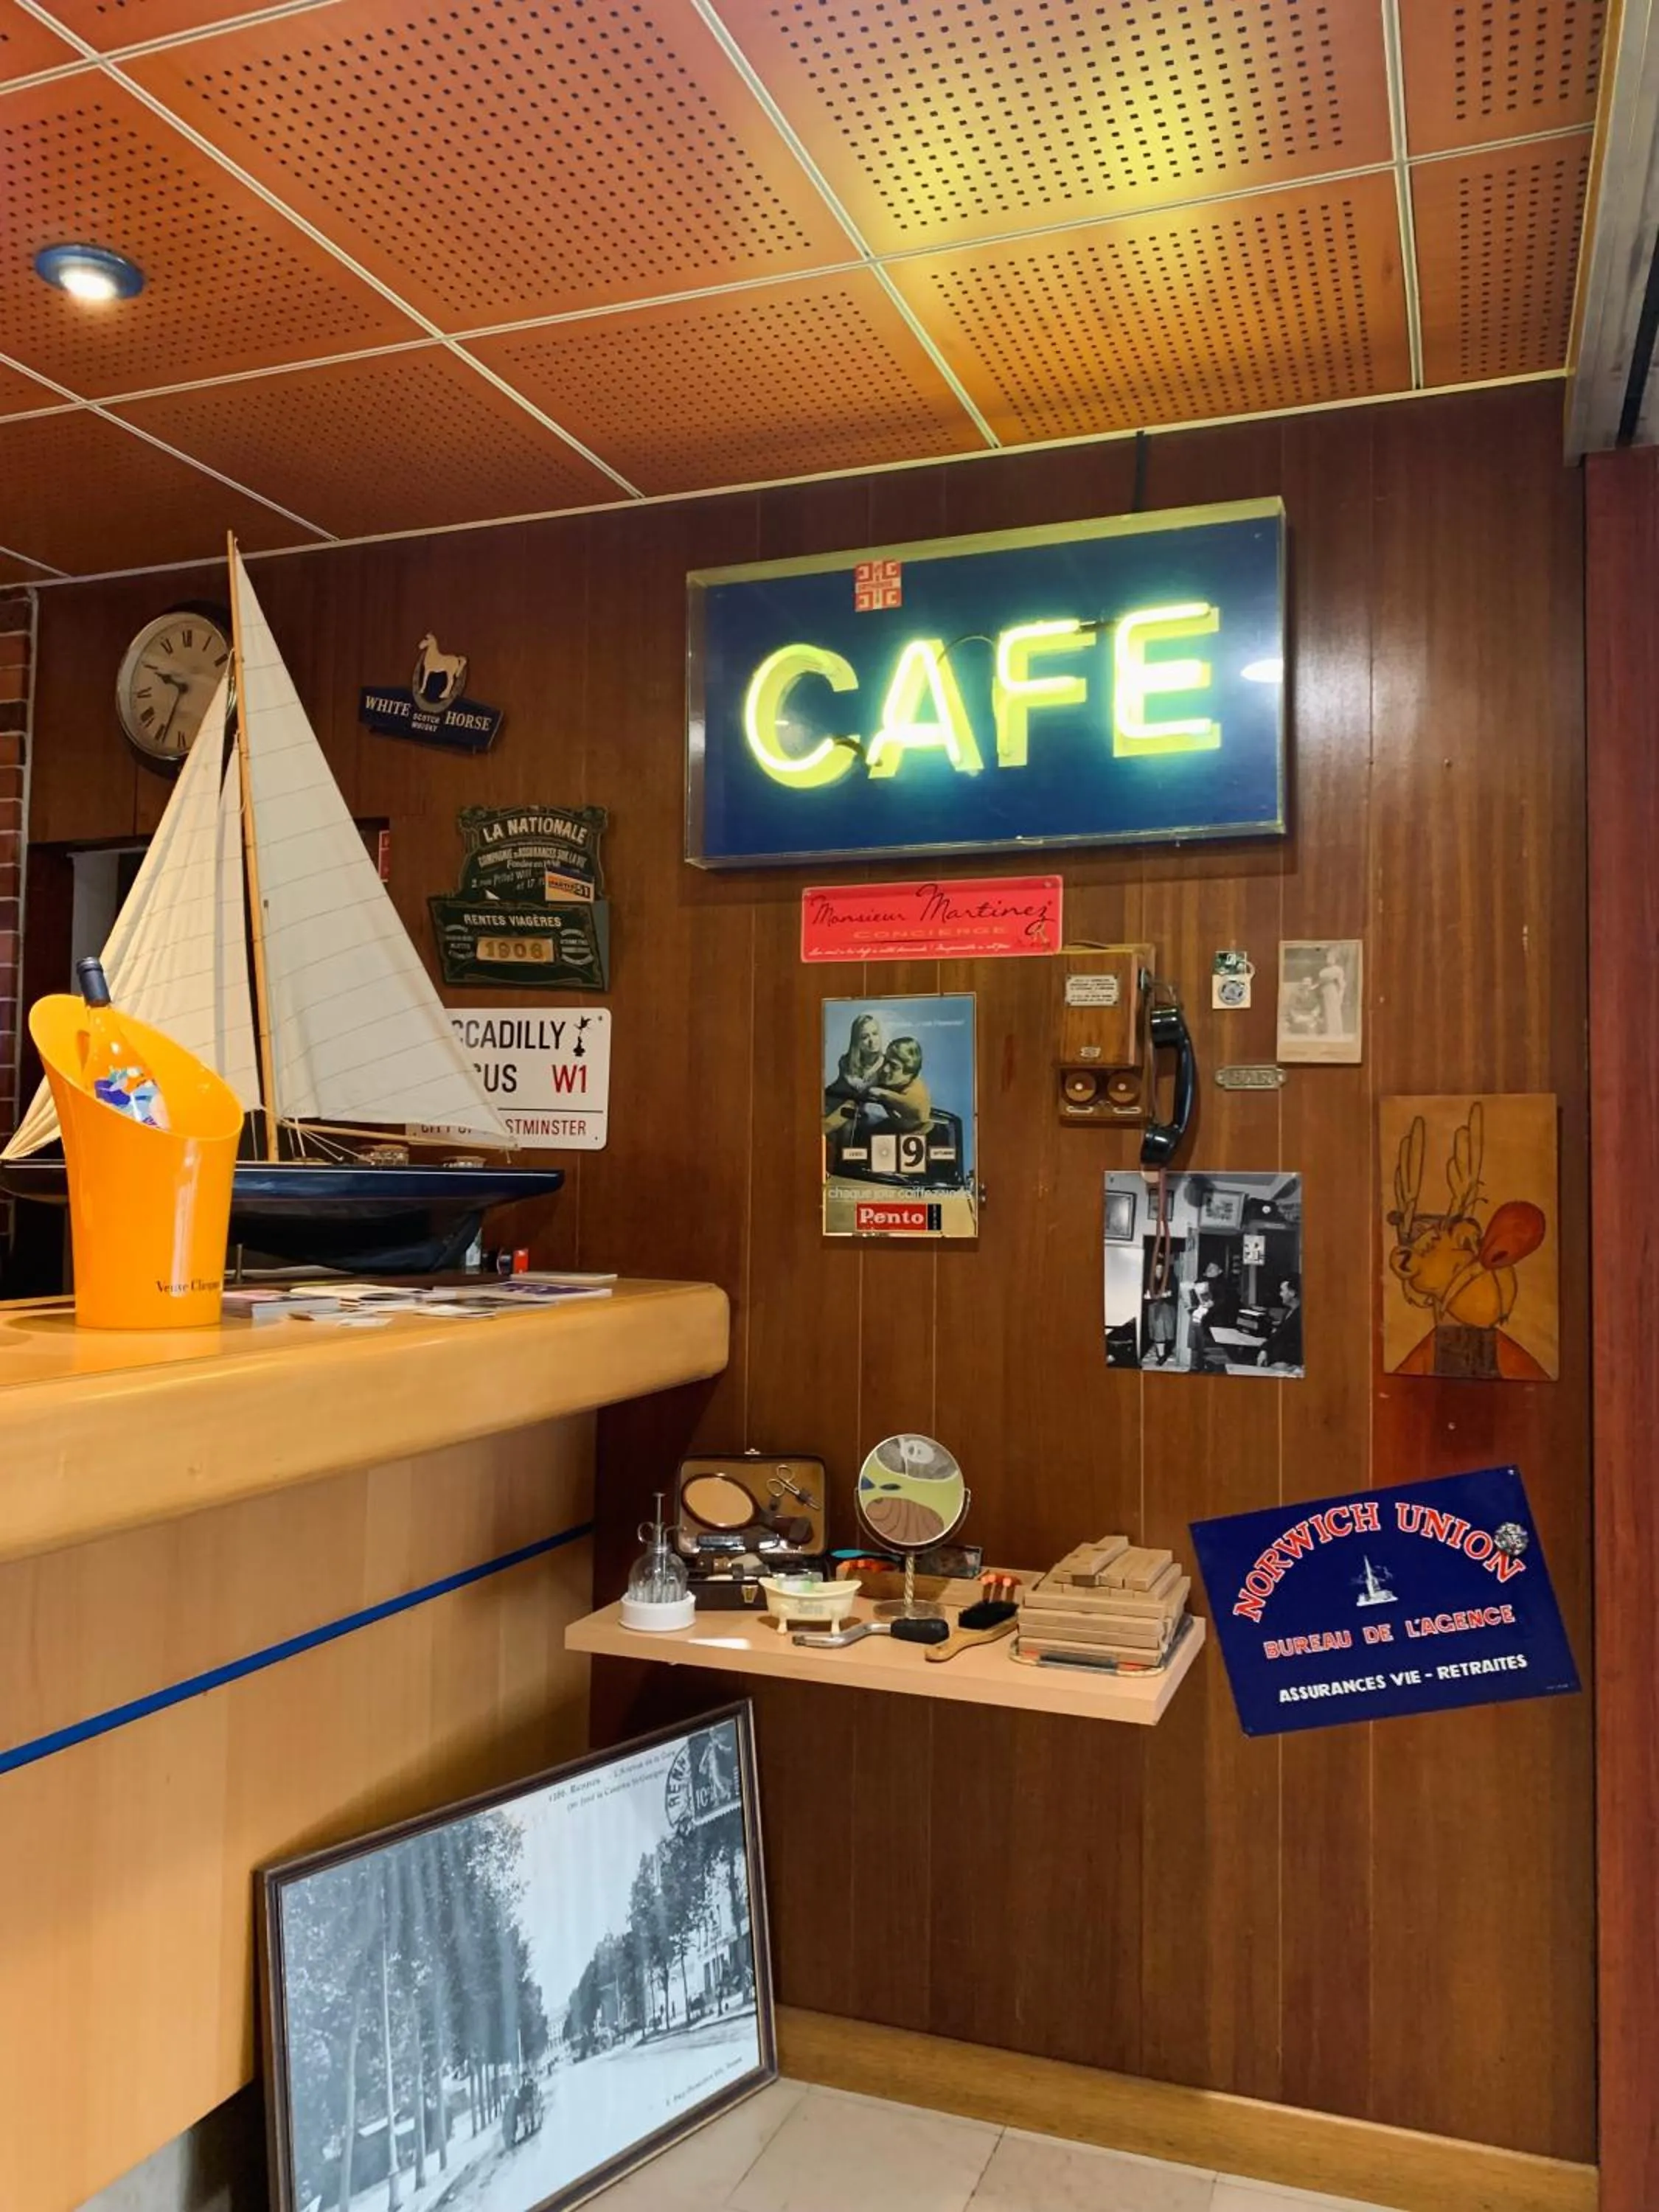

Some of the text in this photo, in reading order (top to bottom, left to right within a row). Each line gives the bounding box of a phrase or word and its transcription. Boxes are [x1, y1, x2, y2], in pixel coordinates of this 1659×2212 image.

[744, 602, 1221, 789] CAFE
[366, 695, 493, 731] WHITE HORSE
[483, 816, 588, 845] LA NATIONALE
[464, 914, 562, 928] RENTES VIAGÈRES
[810, 883, 1056, 936] Monsieur Martinez
[853, 926, 1007, 940] CONCIERGE
[552, 1065, 587, 1093] W1
[902, 1136, 925, 1167] 9
[859, 1207, 925, 1225] Pento
[1233, 1502, 1527, 1623] NORWICH UNION
[1263, 1604, 1516, 1659] BUREAU DE L'AGENCE
[1279, 1674, 1386, 1703] ASSURANCES
[1389, 1670, 1422, 1686] VIE
[1436, 1654, 1528, 1680] RETRAITES
